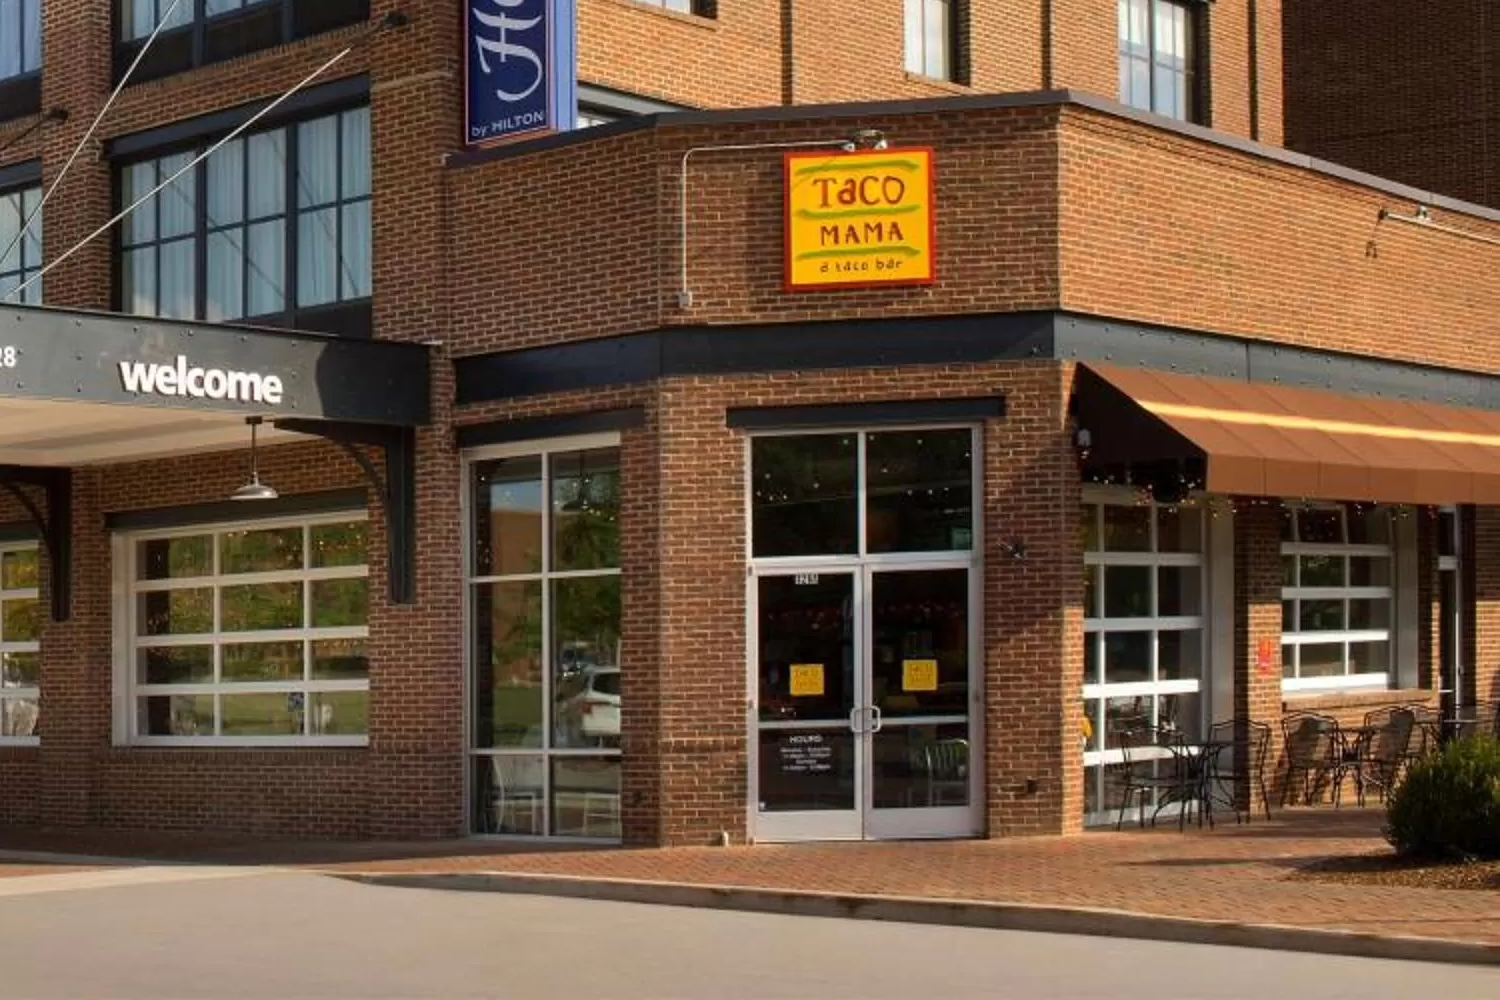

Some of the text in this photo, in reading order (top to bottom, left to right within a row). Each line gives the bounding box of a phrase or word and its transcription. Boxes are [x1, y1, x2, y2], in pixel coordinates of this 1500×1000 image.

[471, 111, 544, 137] by HILTON
[820, 221, 904, 246] MAMA
[820, 256, 903, 273] a taco bar
[118, 355, 283, 403] welcome
